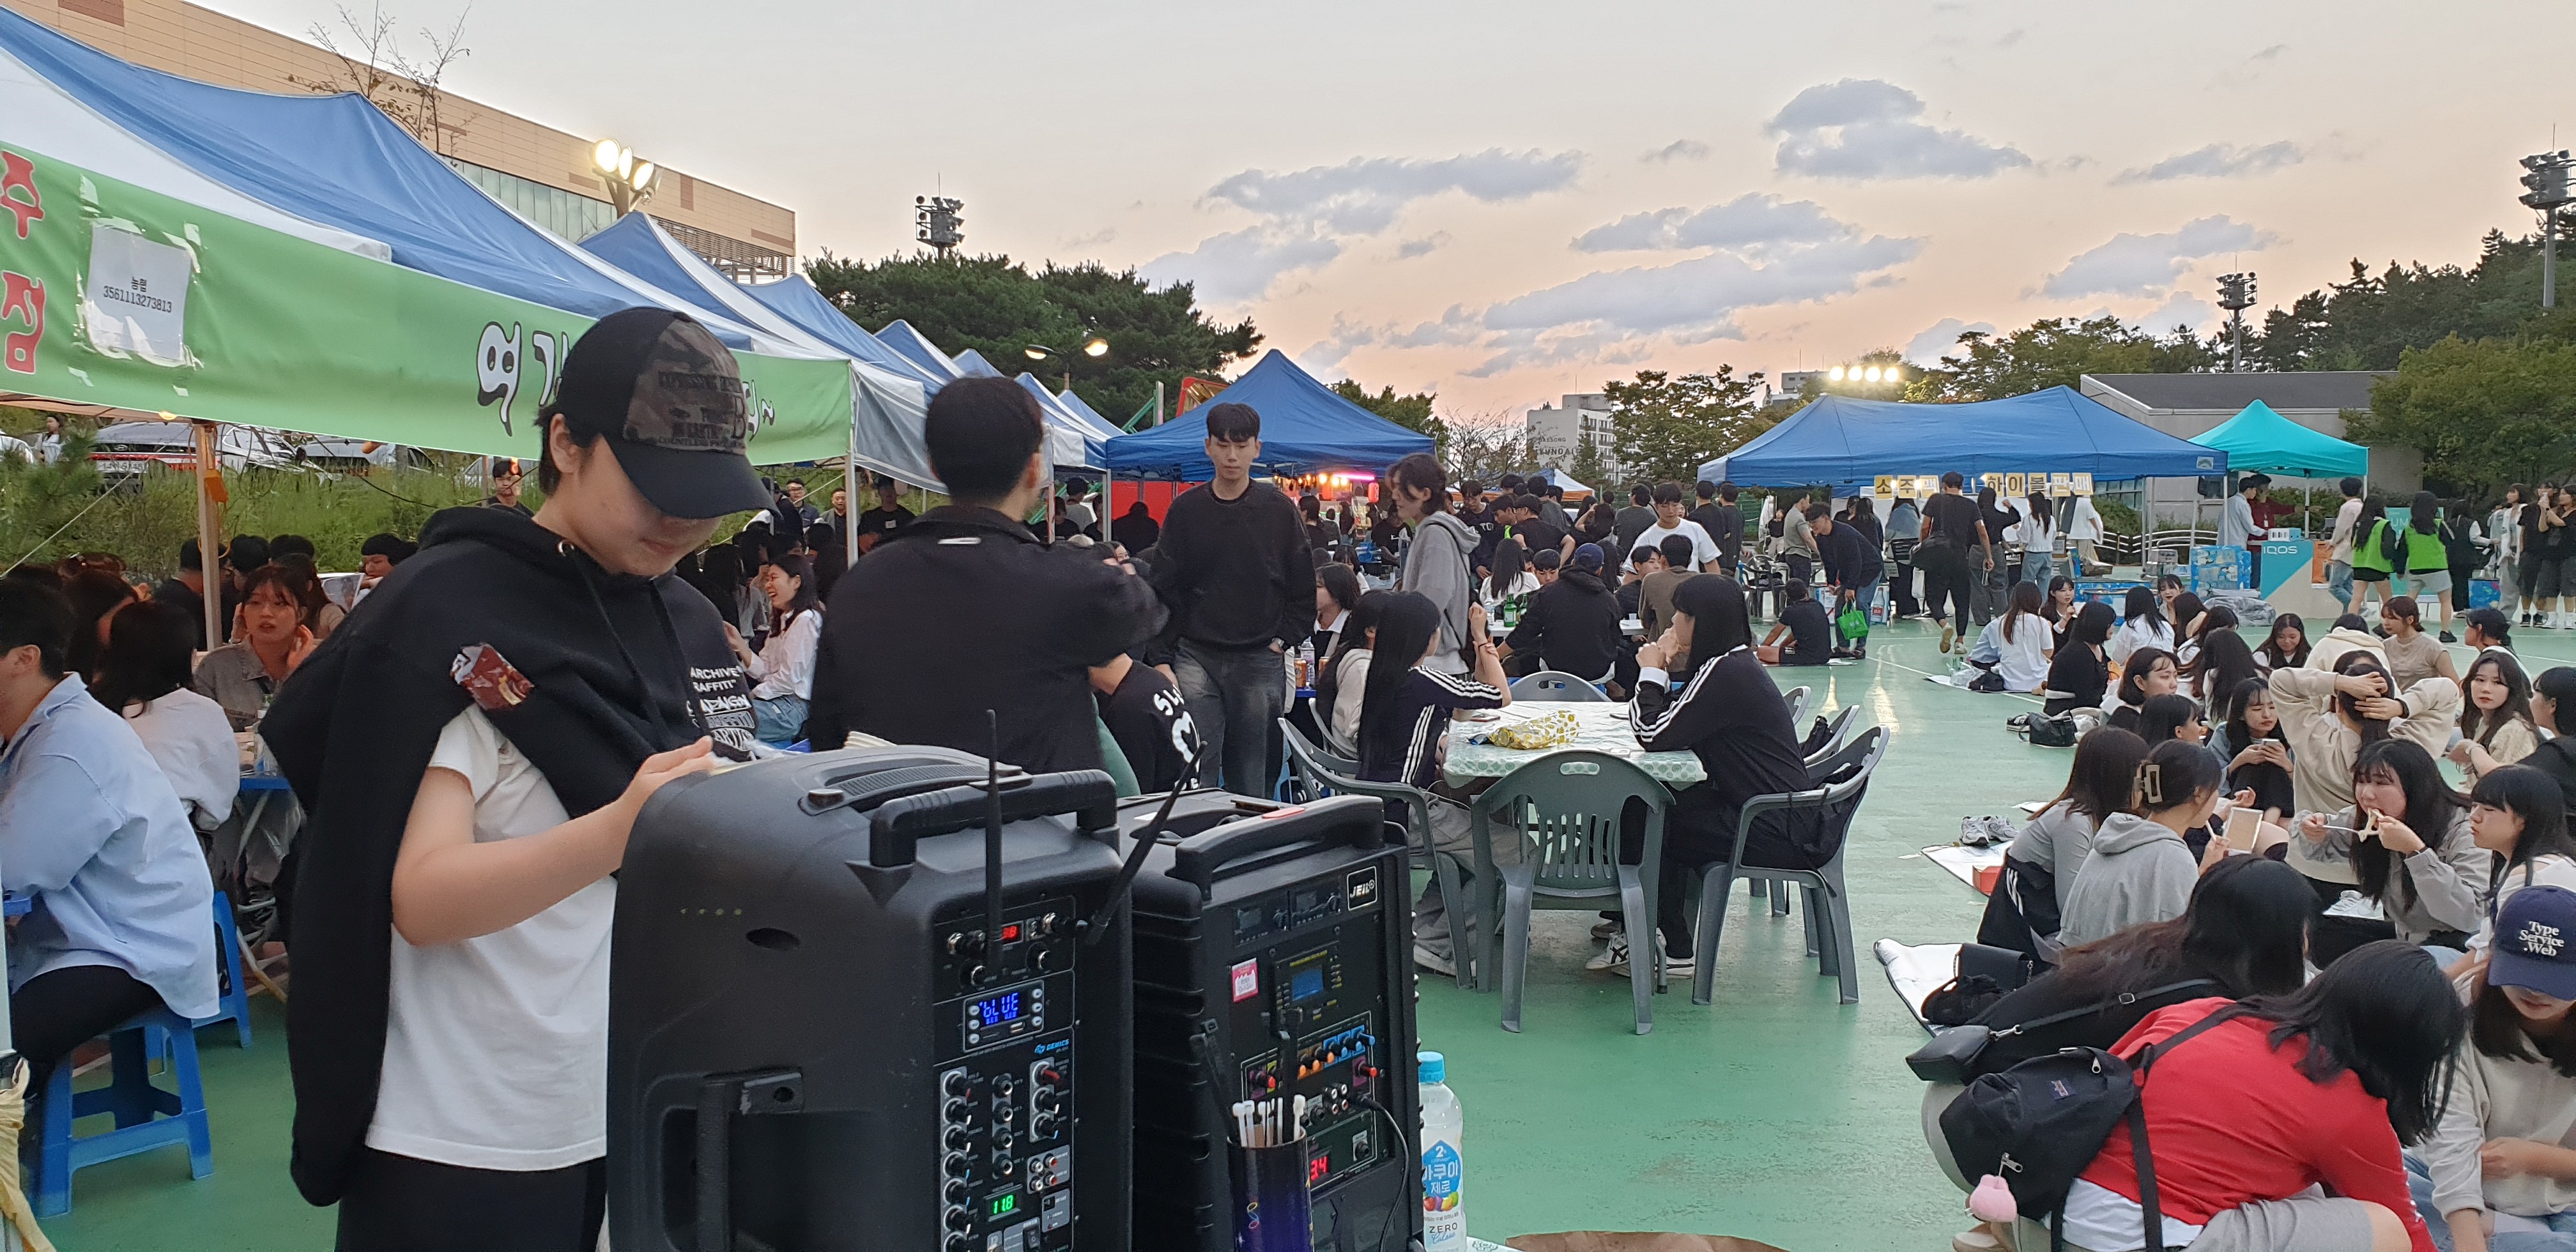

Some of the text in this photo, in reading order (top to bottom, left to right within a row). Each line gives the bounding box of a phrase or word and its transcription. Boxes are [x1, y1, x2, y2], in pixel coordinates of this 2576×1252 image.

[131, 276, 147, 293] 농협
[103, 286, 172, 313] 3561113273813
[2263, 546, 2298, 555] IQOS
[2529, 920, 2560, 936] Type
[2518, 929, 2565, 947] Service
[1423, 1159, 1459, 1181] 아쿠아
[1430, 1180, 1452, 1194] 제로
[1429, 1222, 1458, 1233] ZERO
